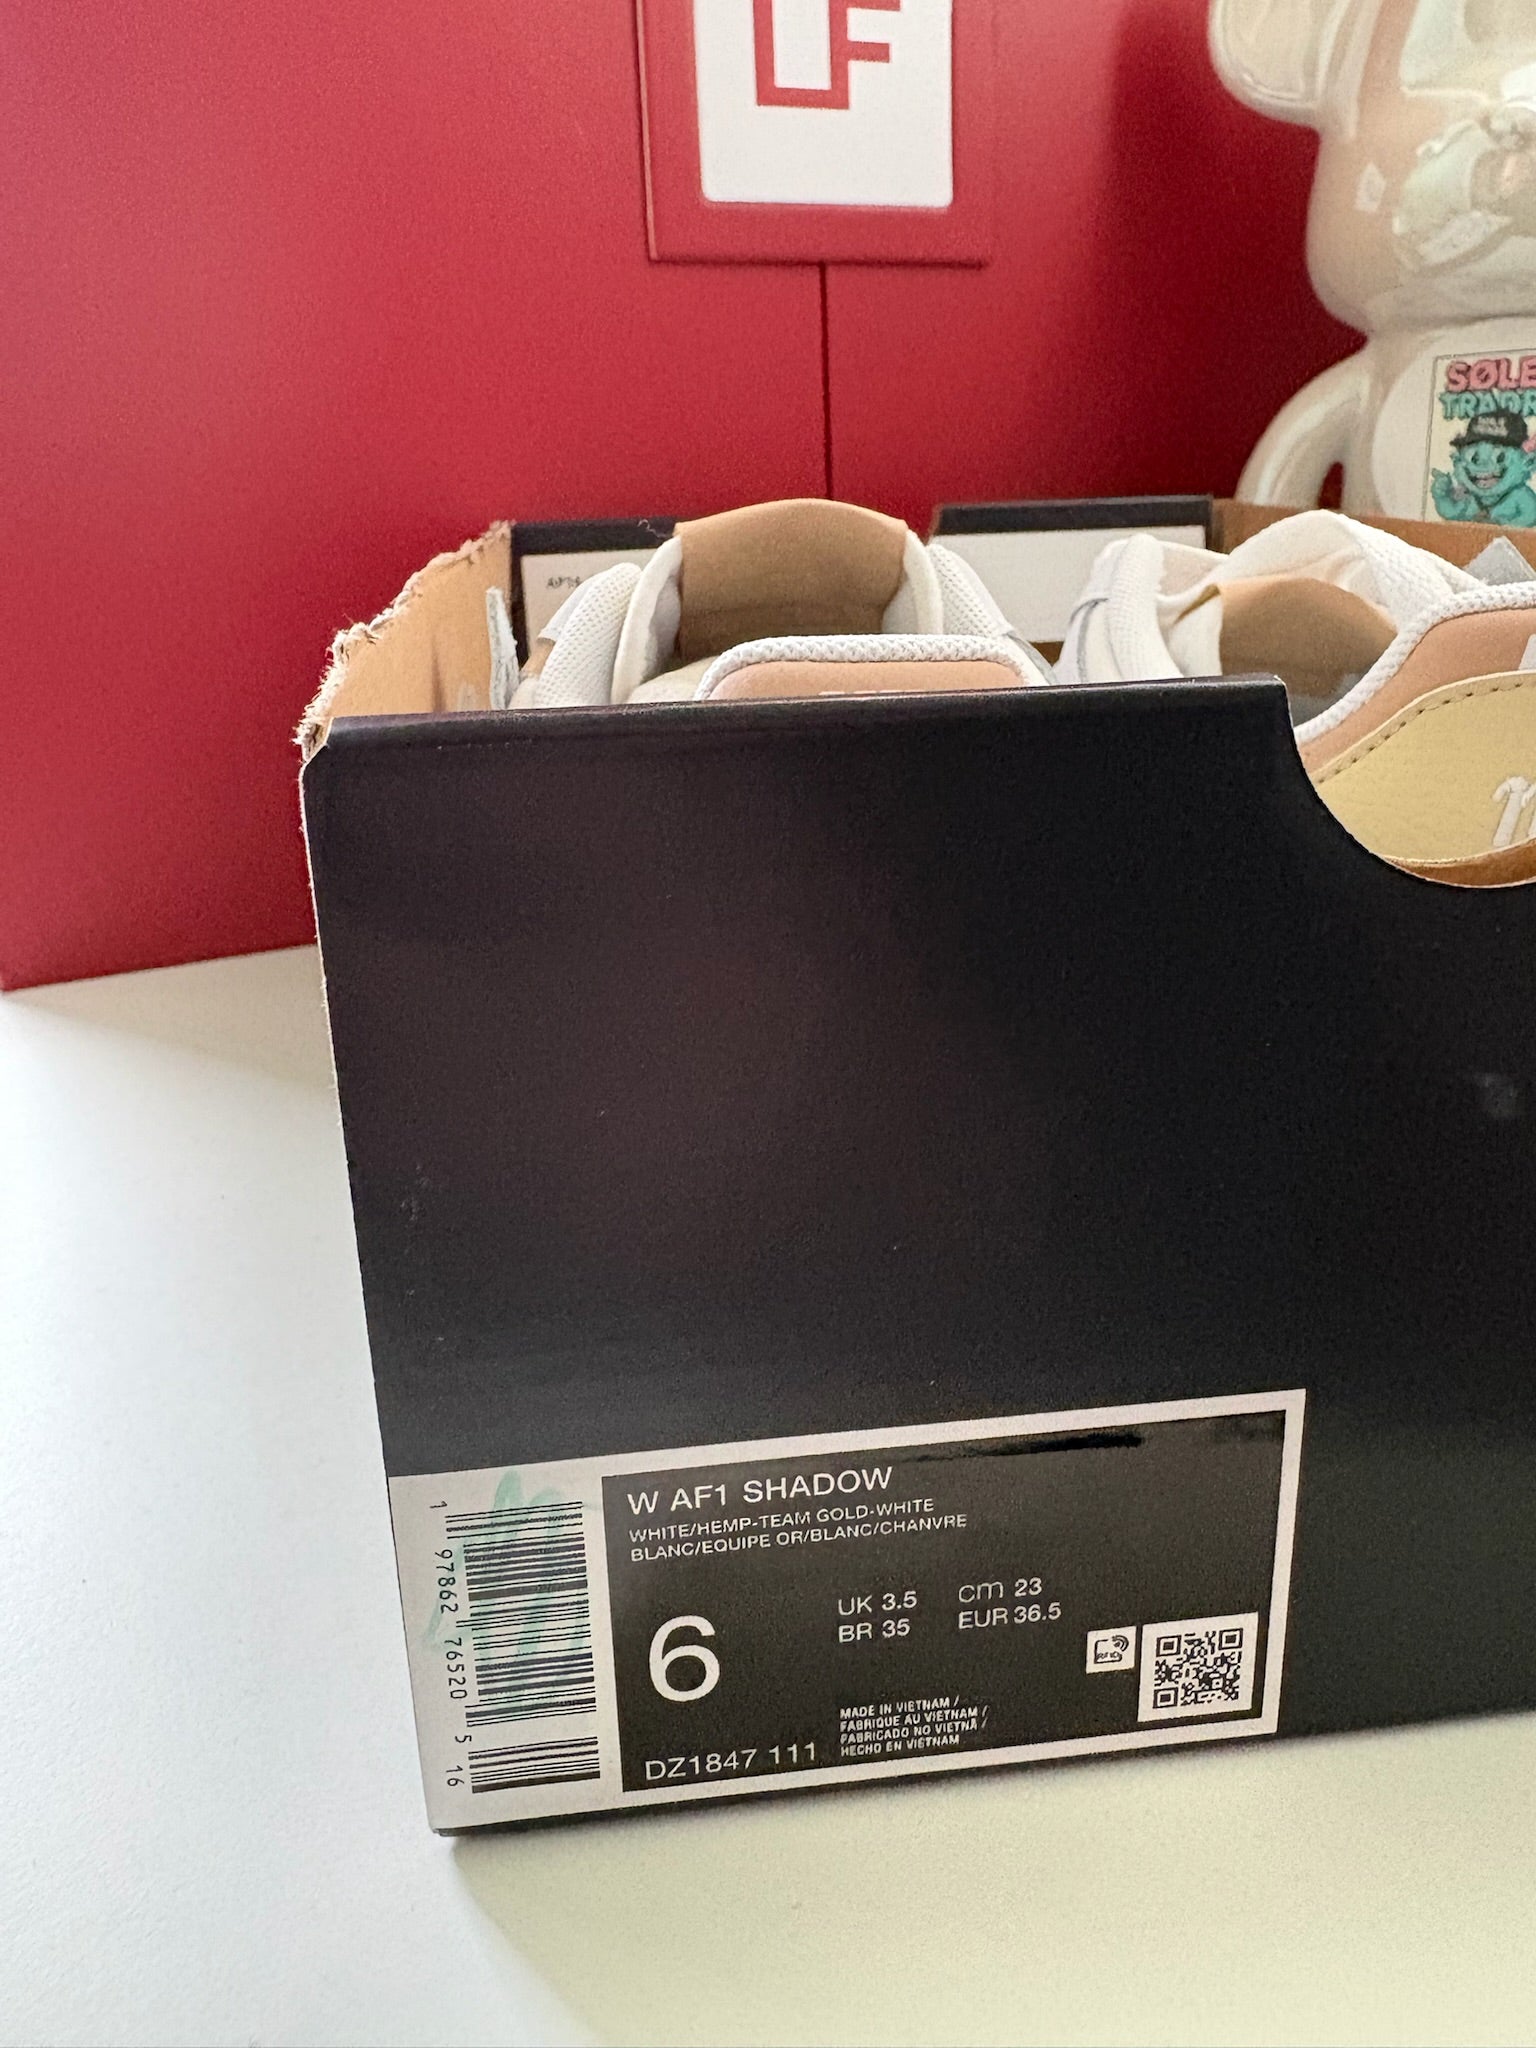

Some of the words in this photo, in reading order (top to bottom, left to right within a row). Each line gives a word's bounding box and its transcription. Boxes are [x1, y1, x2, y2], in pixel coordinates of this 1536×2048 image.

[627, 1491, 659, 1515] W
[670, 1484, 727, 1512] AF1
[743, 1466, 893, 1503] SHADOW
[629, 1511, 811, 1543] WHITE/HEMP-TEAM
[817, 1499, 935, 1523] GOLD-WHITE
[631, 1535, 771, 1562] BLANC/EQUIPE
[776, 1515, 968, 1548] OR/BLANC/CHANVRE
[434, 1549, 459, 1614] 97862
[958, 1582, 1004, 1603] cm
[1014, 1577, 1043, 1598] 23
[838, 1595, 873, 1616] UK
[881, 1591, 918, 1610] 3.5
[958, 1608, 1009, 1630] EUR
[1013, 1602, 1062, 1624] 36.5
[838, 1622, 873, 1643] BR
[881, 1619, 911, 1638] 35
[444, 1637, 468, 1700] 76520
[648, 1614, 720, 1702] 6
[840, 1705, 875, 1719] MADE
[879, 1703, 892, 1714] IN
[896, 1697, 950, 1713] VIETNAM
[840, 1715, 901, 1732] FABRIQUE
[904, 1713, 921, 1726] AU
[924, 1706, 978, 1723] VIETNAM
[913, 1724, 931, 1737] NO
[840, 1743, 882, 1757] HECHO
[886, 1740, 902, 1752] EN
[906, 1734, 960, 1750] VIETNAM
[645, 1749, 756, 1780] DZ1847
[769, 1742, 817, 1764] 111
